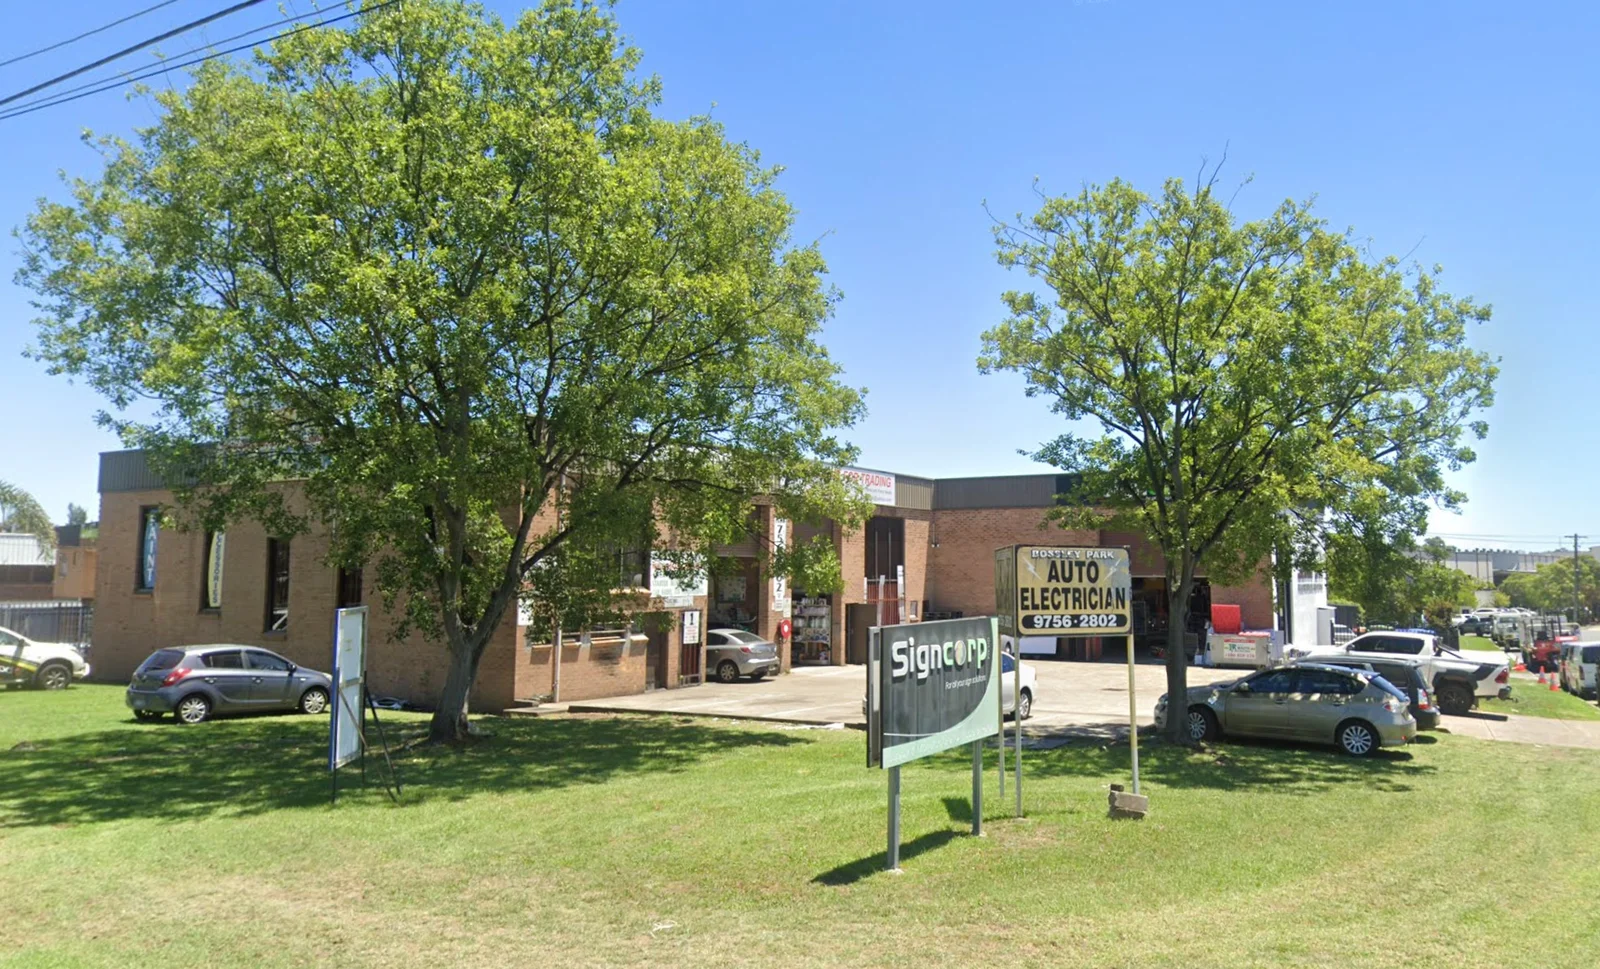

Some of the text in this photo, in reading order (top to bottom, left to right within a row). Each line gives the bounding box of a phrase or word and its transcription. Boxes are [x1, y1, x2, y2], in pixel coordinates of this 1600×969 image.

[861, 473, 892, 488] TRADING
[1031, 549, 1115, 559] BOSSLEY PARK
[1047, 560, 1099, 583] AUTO
[1020, 587, 1126, 611] ELECTRICIAN
[891, 636, 987, 679] Signcorp
